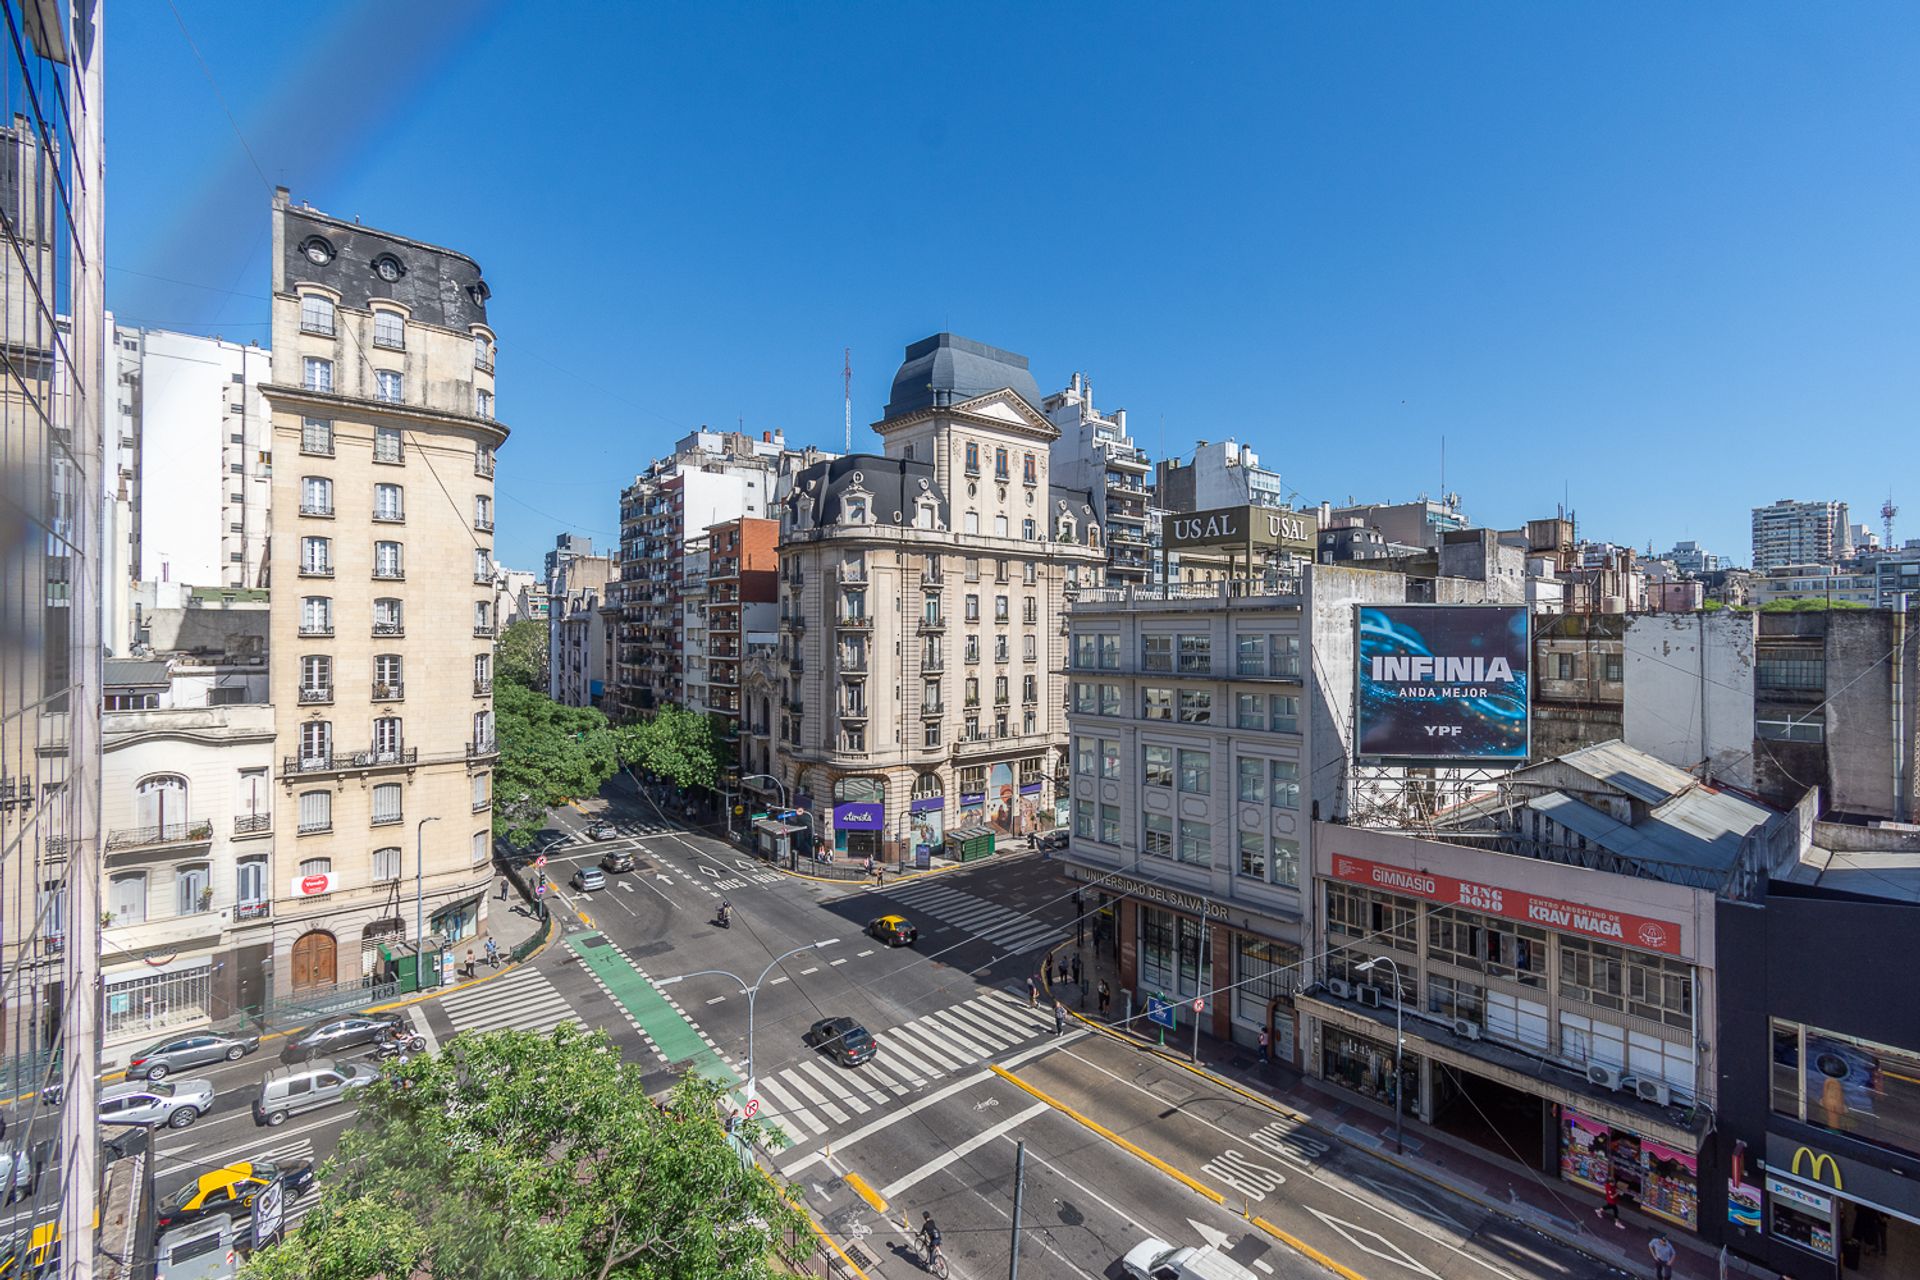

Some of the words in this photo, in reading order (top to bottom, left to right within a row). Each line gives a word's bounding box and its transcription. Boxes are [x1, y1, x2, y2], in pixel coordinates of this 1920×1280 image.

[1173, 514, 1237, 540] USAL
[1268, 514, 1308, 541] USAL
[1372, 656, 1515, 682] INFINIA
[1400, 687, 1436, 698] ANDA
[1442, 687, 1488, 698] MEJOR
[1424, 725, 1463, 736] YPF
[714, 878, 748, 891] BUS
[1372, 868, 1436, 894] GIMNASIO
[1459, 882, 1503, 902] KING
[1085, 870, 1146, 896] UNIVERSIDAD
[1149, 888, 1168, 903] DEL
[1170, 893, 1229, 920] SALVADOR
[1459, 893, 1503, 912] DOJO
[1528, 905, 1569, 926] KRAV
[1573, 914, 1624, 938] MAGA
[1529, 898, 1560, 911] CENTRO
[1561, 904, 1607, 920] ARGENTINO
[1608, 914, 1620, 923] DE
[1249, 1122, 1331, 1166] BUS
[1200, 1149, 1287, 1202] BUS
